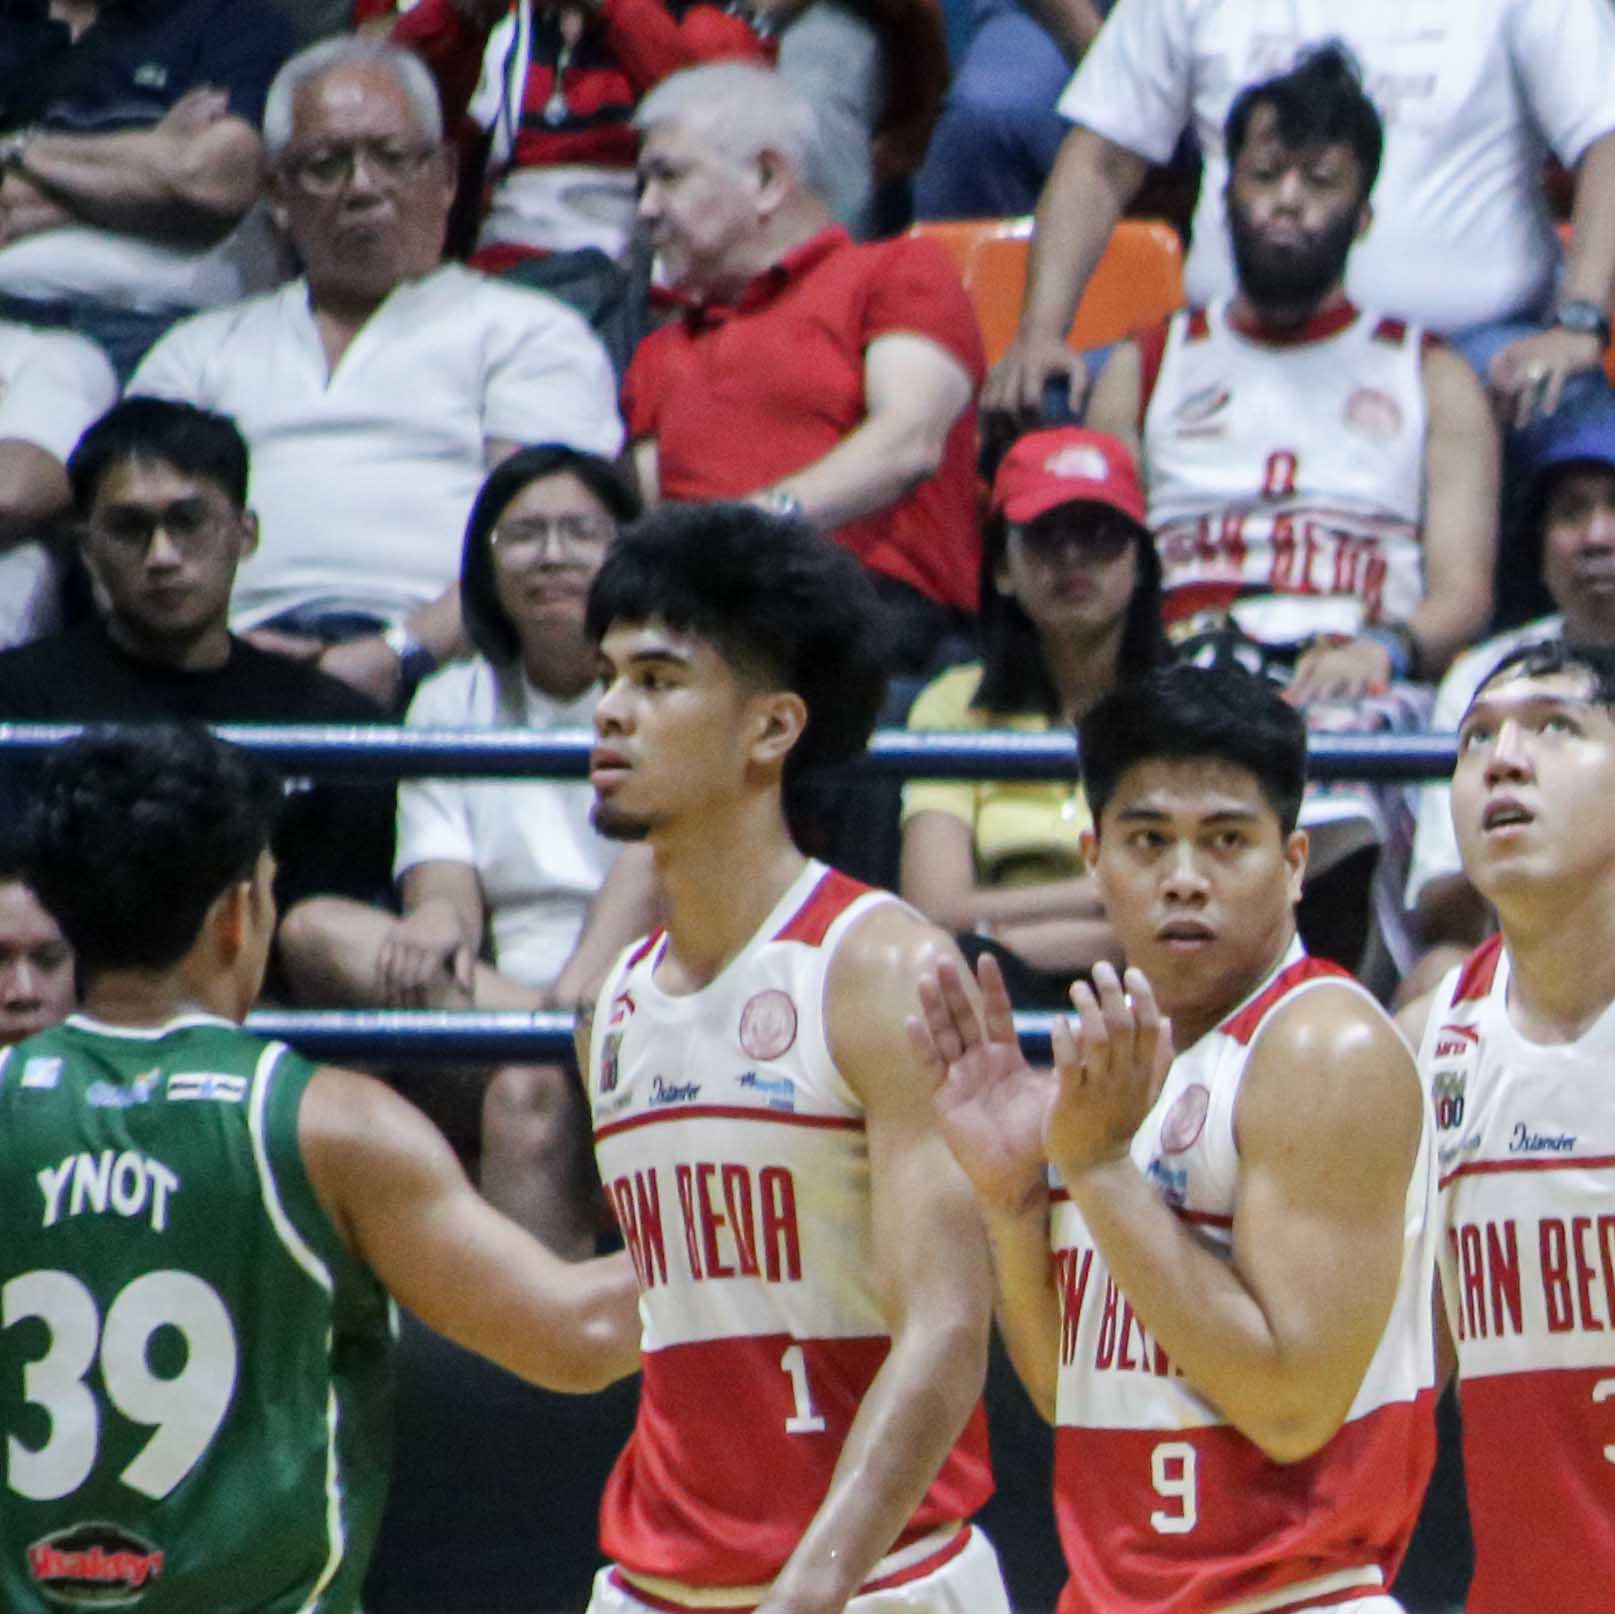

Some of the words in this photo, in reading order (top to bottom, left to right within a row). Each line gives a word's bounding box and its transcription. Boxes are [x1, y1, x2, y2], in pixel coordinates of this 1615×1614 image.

[37, 1149, 181, 1233] YNOT
[1, 1269, 239, 1500] 39
[781, 1345, 826, 1433] 1
[1150, 1441, 1199, 1534] 9
